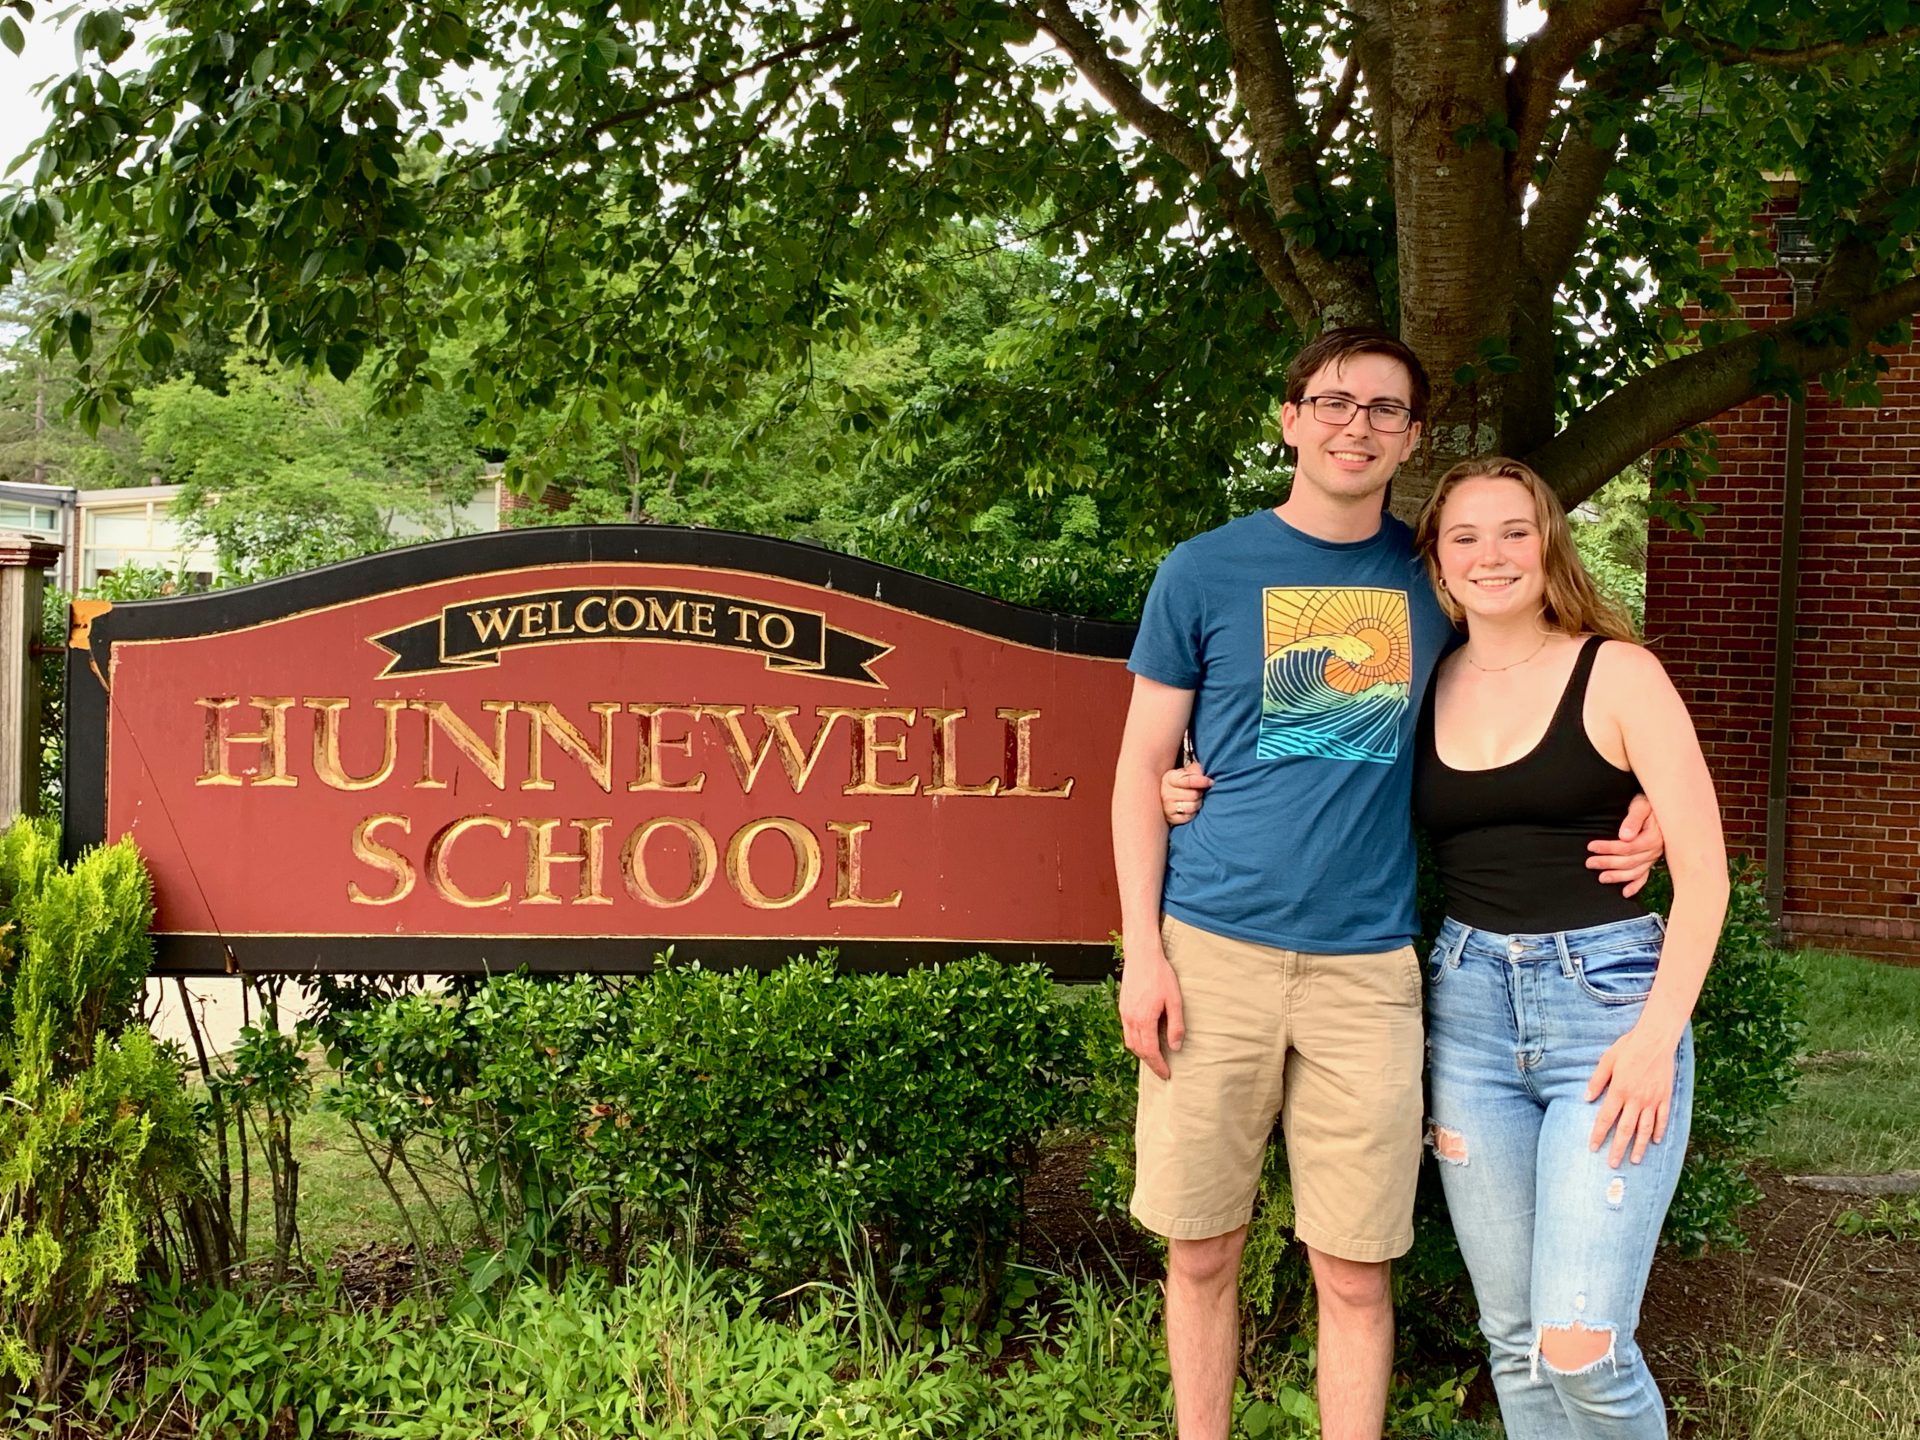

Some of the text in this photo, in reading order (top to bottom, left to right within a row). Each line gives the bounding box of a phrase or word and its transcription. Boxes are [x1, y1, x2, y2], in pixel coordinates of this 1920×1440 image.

[467, 596, 795, 650] WELCOME TO
[194, 696, 1075, 798] HUNNEWELL
[347, 814, 903, 909] SCHOOL
